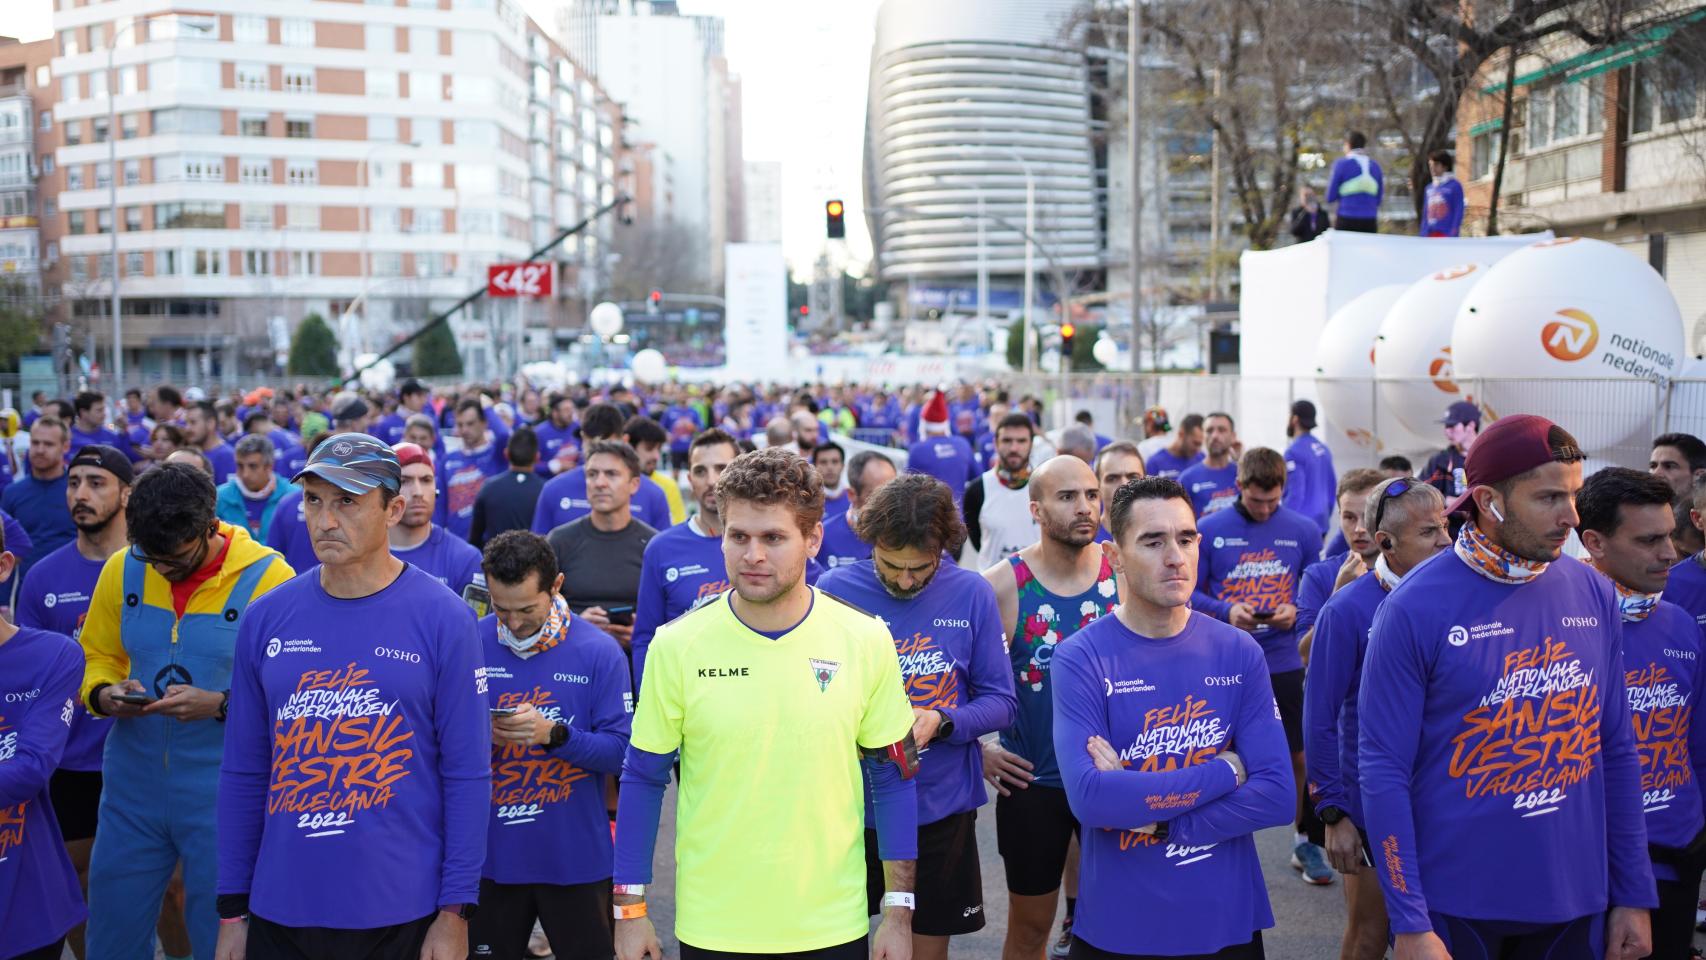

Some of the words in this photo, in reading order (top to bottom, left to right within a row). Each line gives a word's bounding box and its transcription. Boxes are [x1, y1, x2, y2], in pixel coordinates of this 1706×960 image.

[1610, 333, 1675, 371] nationale
[933, 618, 969, 628] OYSHO
[1470, 620, 1503, 632] nationale
[1561, 616, 1598, 627] OYSHO
[284, 638, 313, 646] nationale
[1472, 627, 1515, 640] nederlanden
[283, 645, 321, 653] nederlanden
[374, 646, 420, 663] OYSHO
[1663, 648, 1696, 660] OYSHO
[553, 673, 589, 684] OYSHO
[698, 667, 749, 677] KELME
[1496, 659, 1581, 692] NATIONALE
[288, 686, 380, 708] NATIONALE
[1478, 667, 1594, 708] NEDERLANDEN
[1627, 681, 1678, 702] TIONALE
[277, 698, 400, 721] NEDERLANDEN
[1451, 684, 1600, 743] SANSIL
[1135, 718, 1221, 746] NATIONALE
[1448, 719, 1601, 778] VESTRE
[1466, 757, 1596, 799] VALLECANA
[1641, 765, 1692, 792] ECANA
[268, 786, 397, 820] VALLECANA
[1513, 788, 1567, 809] 2022
[1643, 789, 1676, 806] 022
[297, 812, 355, 829] 2022
[497, 804, 544, 818] 2022
